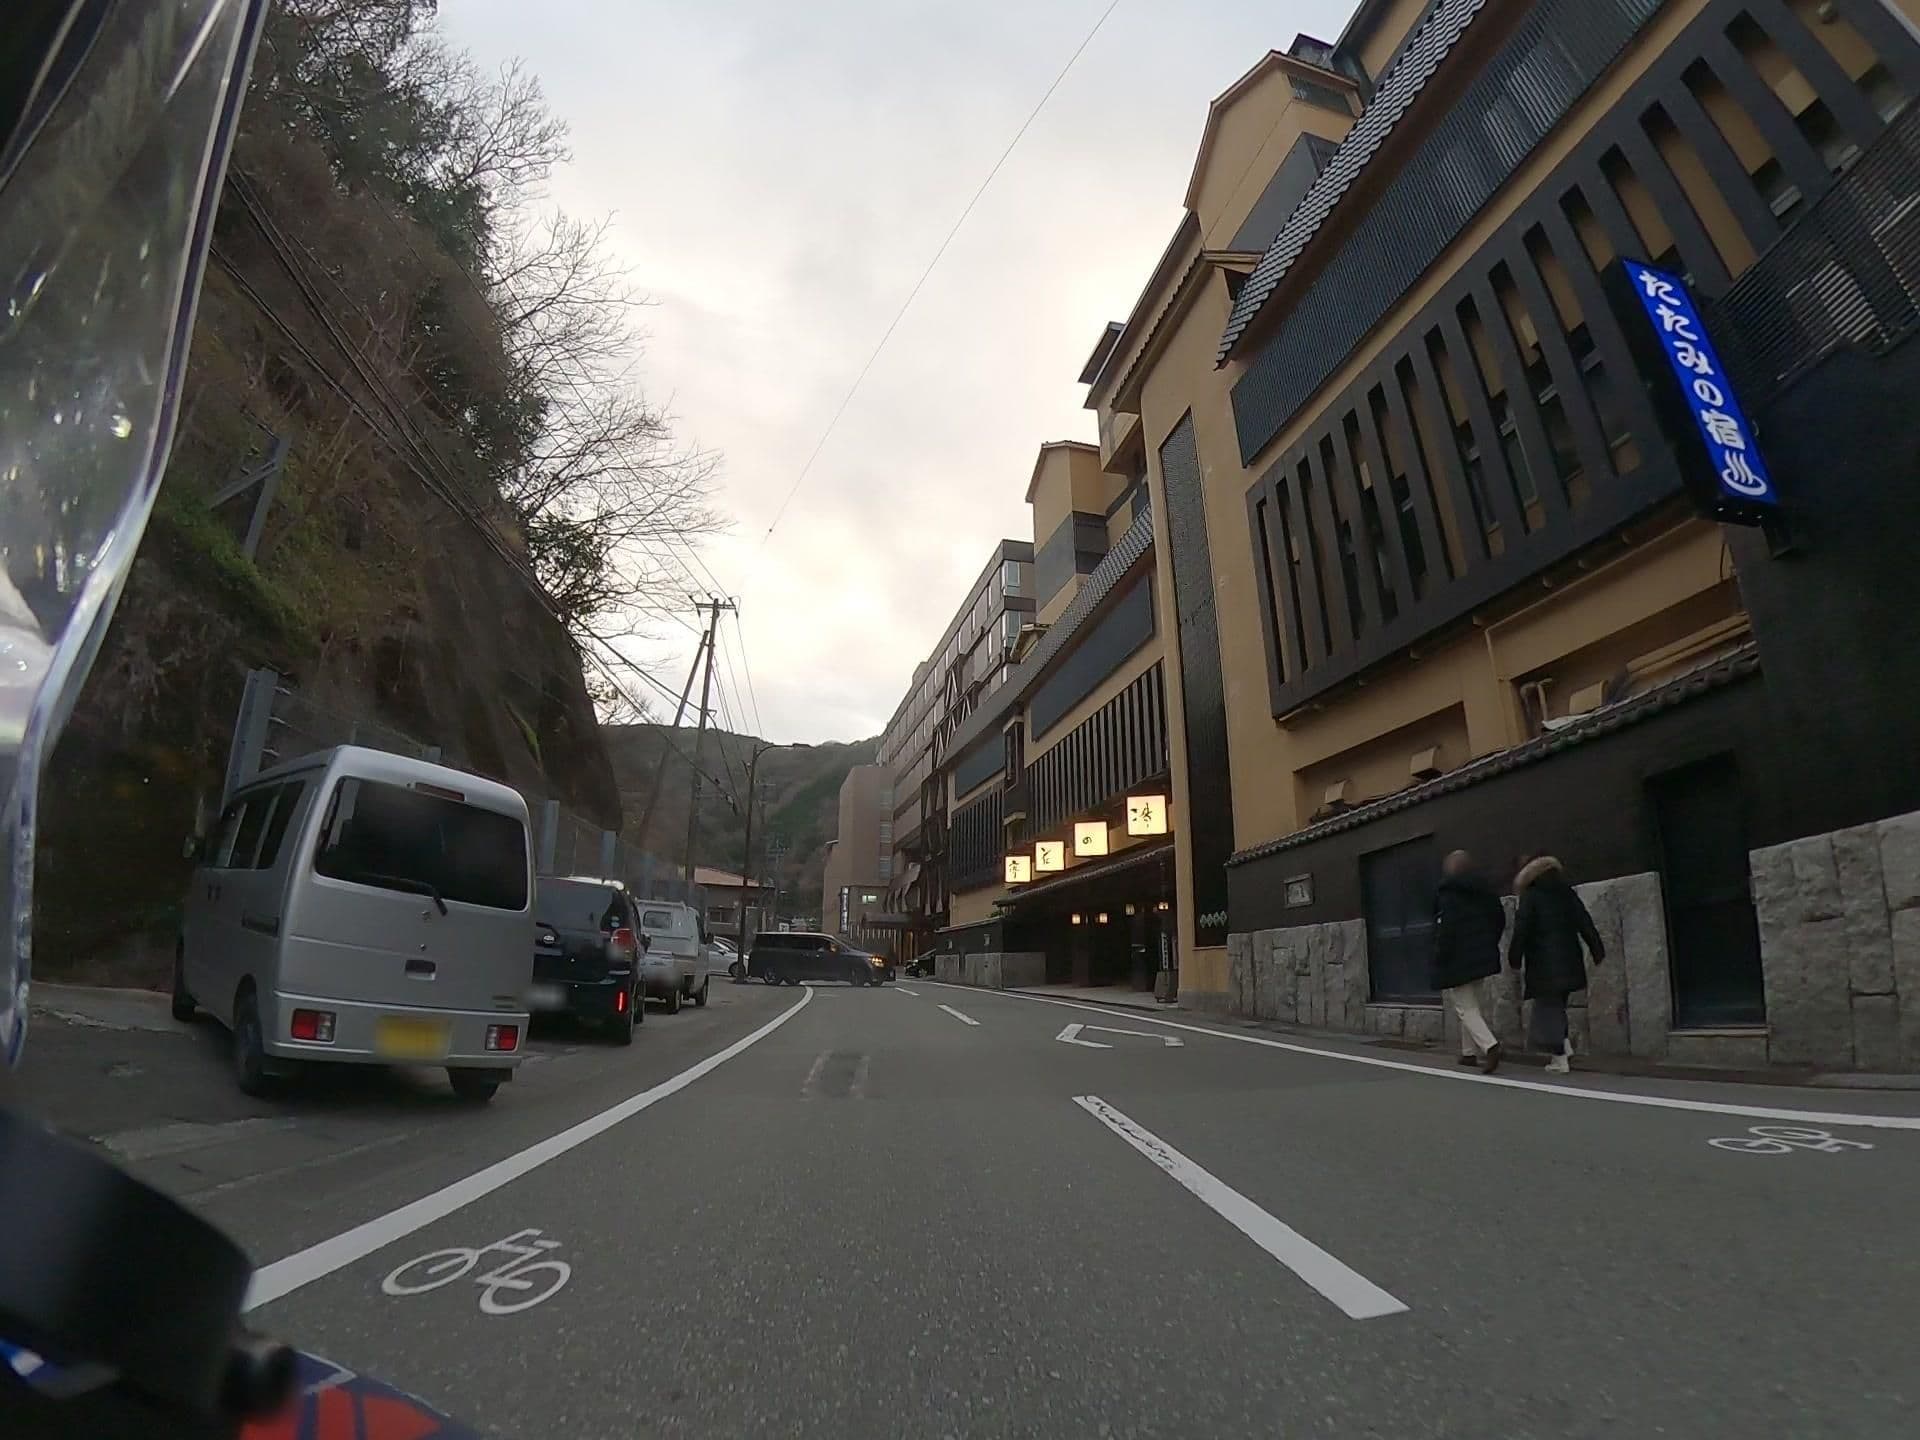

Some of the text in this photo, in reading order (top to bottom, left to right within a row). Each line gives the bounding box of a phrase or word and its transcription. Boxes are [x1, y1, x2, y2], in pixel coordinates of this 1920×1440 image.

[1639, 270, 1746, 450] たたみの宿
